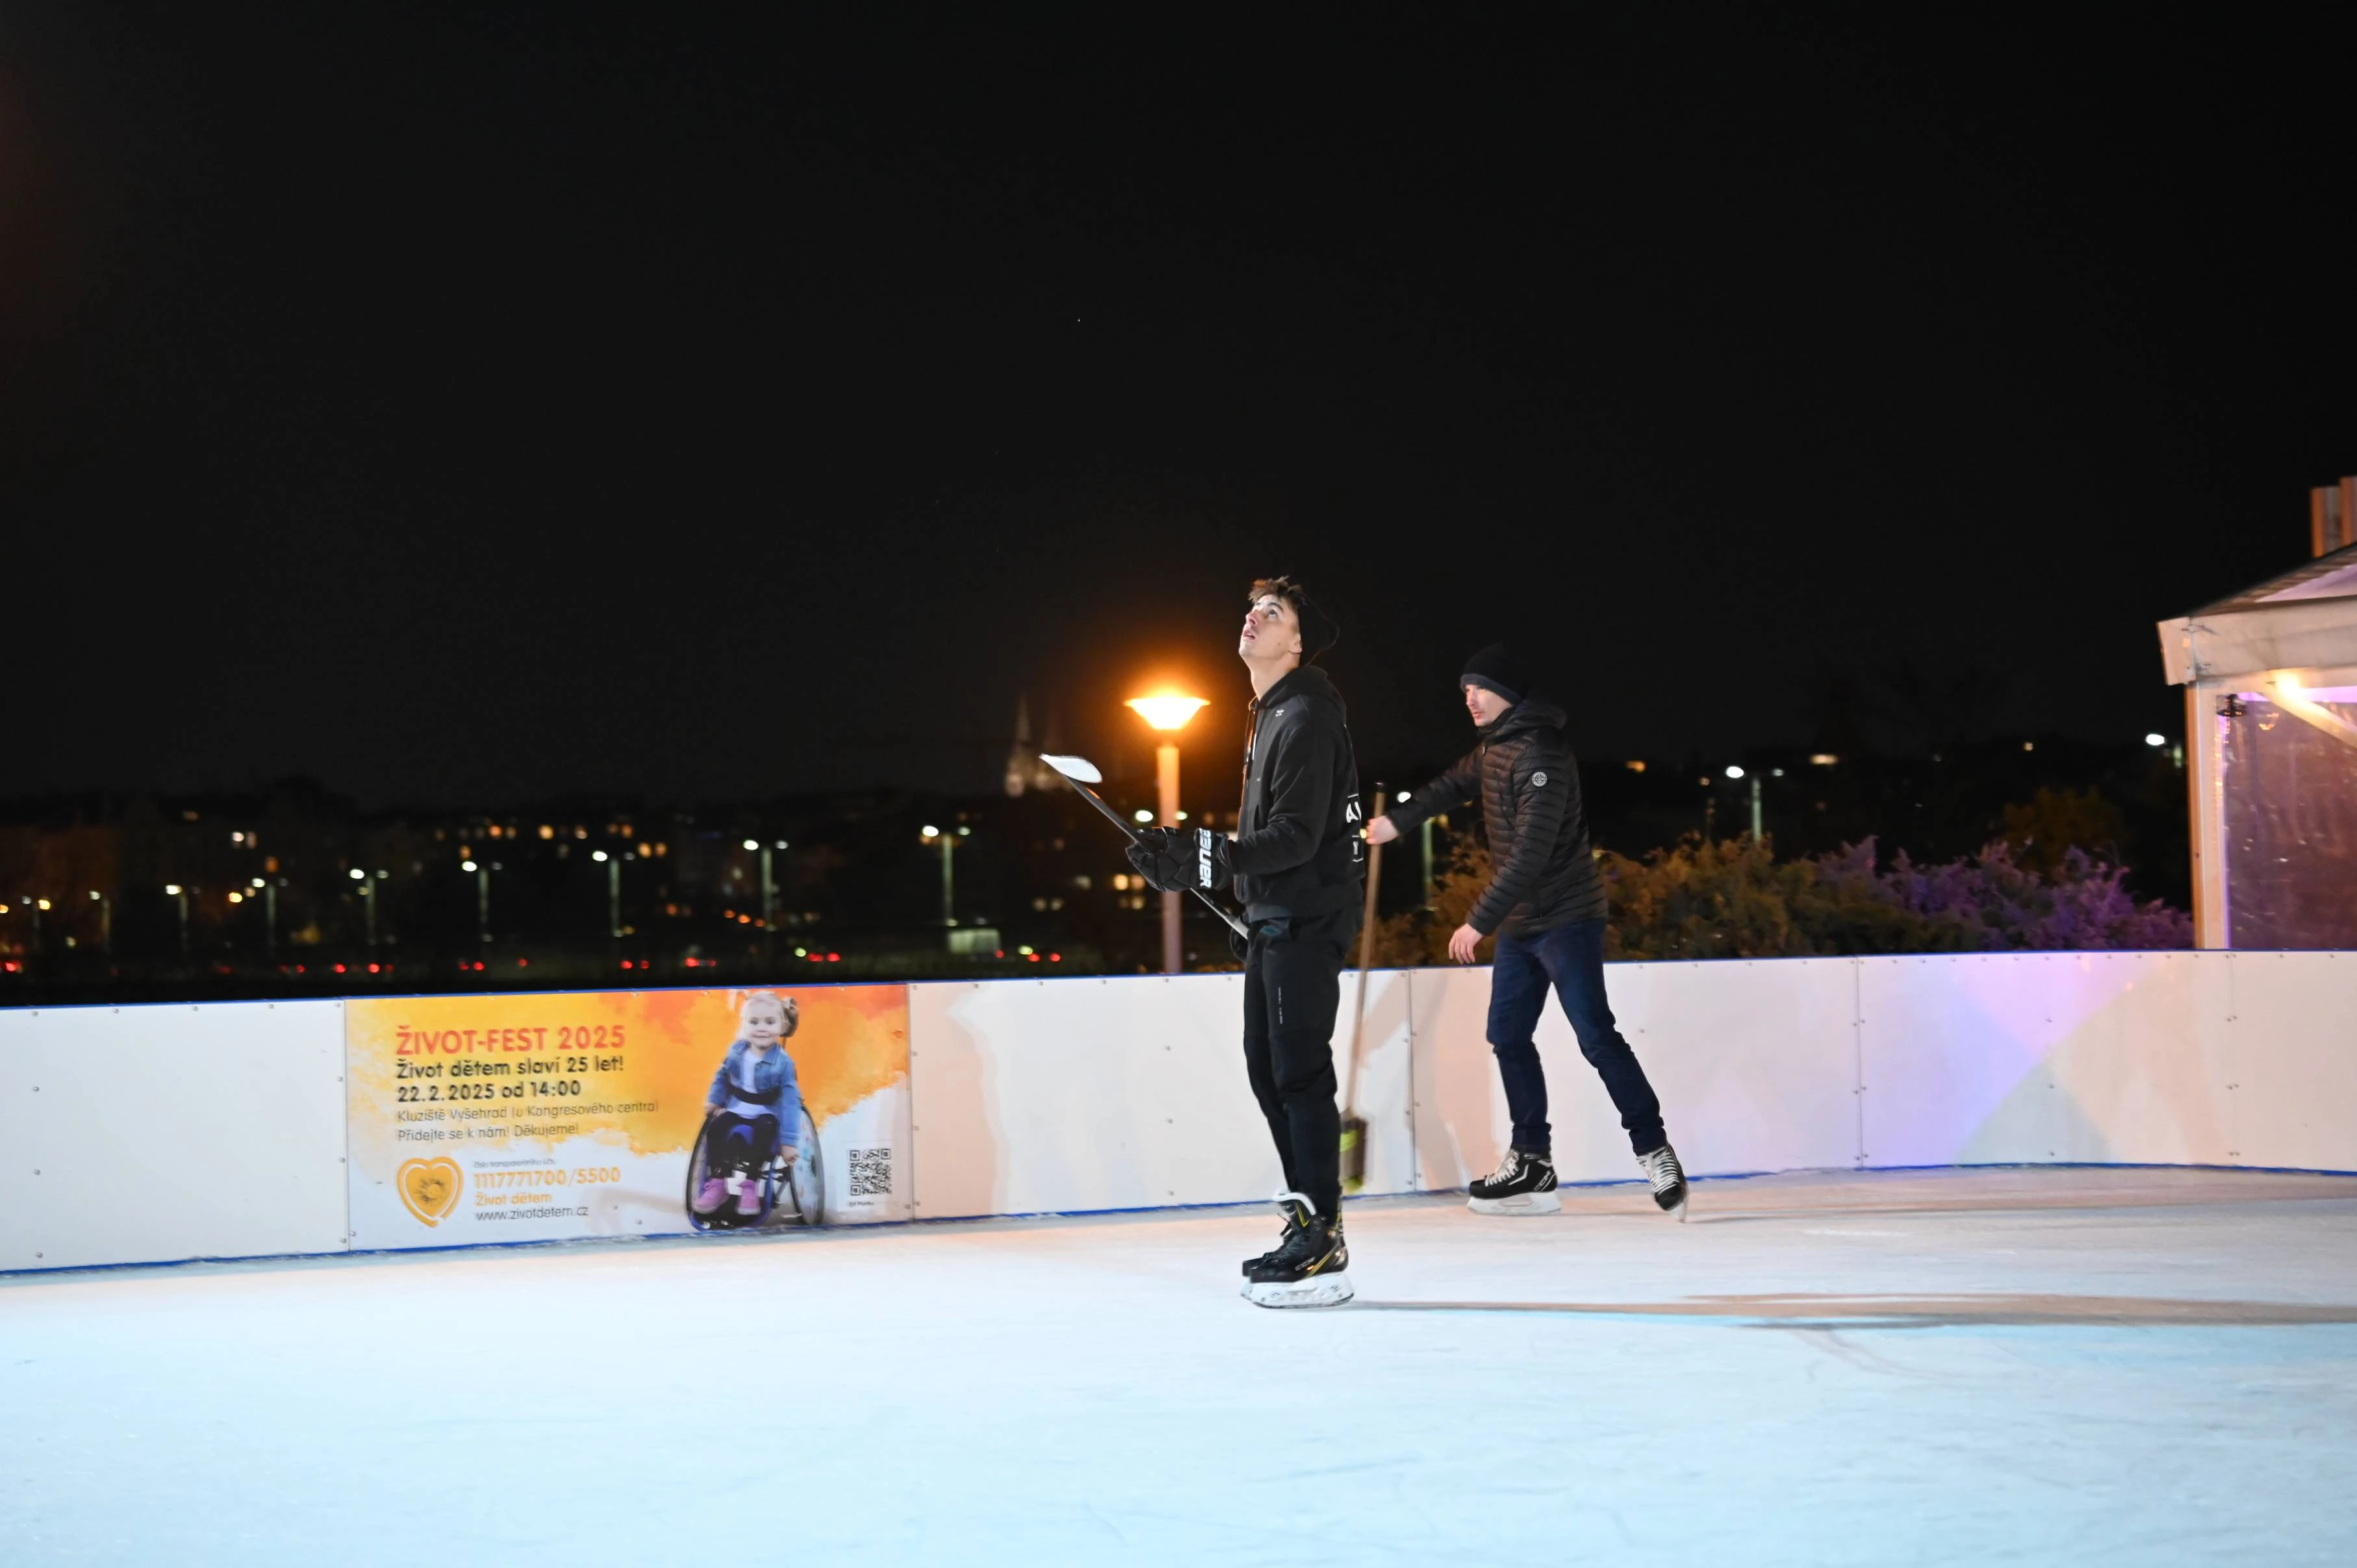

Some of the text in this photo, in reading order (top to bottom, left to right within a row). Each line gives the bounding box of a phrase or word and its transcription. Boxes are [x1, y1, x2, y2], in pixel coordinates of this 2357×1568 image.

[1199, 828, 1212, 889] BAUER
[396, 1024, 626, 1056] ŽIVOT-FEST 2025
[396, 1055, 624, 1080] Život dětem slaví 25 let!
[502, 1081, 524, 1098] od
[530, 1080, 581, 1098] 14:00
[398, 1108, 446, 1122] Kluziště
[450, 1105, 508, 1122] Vyšehrad
[528, 1102, 613, 1119] Kongresového
[617, 1100, 659, 1113] centra)
[398, 1122, 579, 1143] Přidejte se k nám! Děkujeme!
[475, 1191, 552, 1206] Život dětem
[476, 1206, 589, 1221] www.zivotdetem.cz
